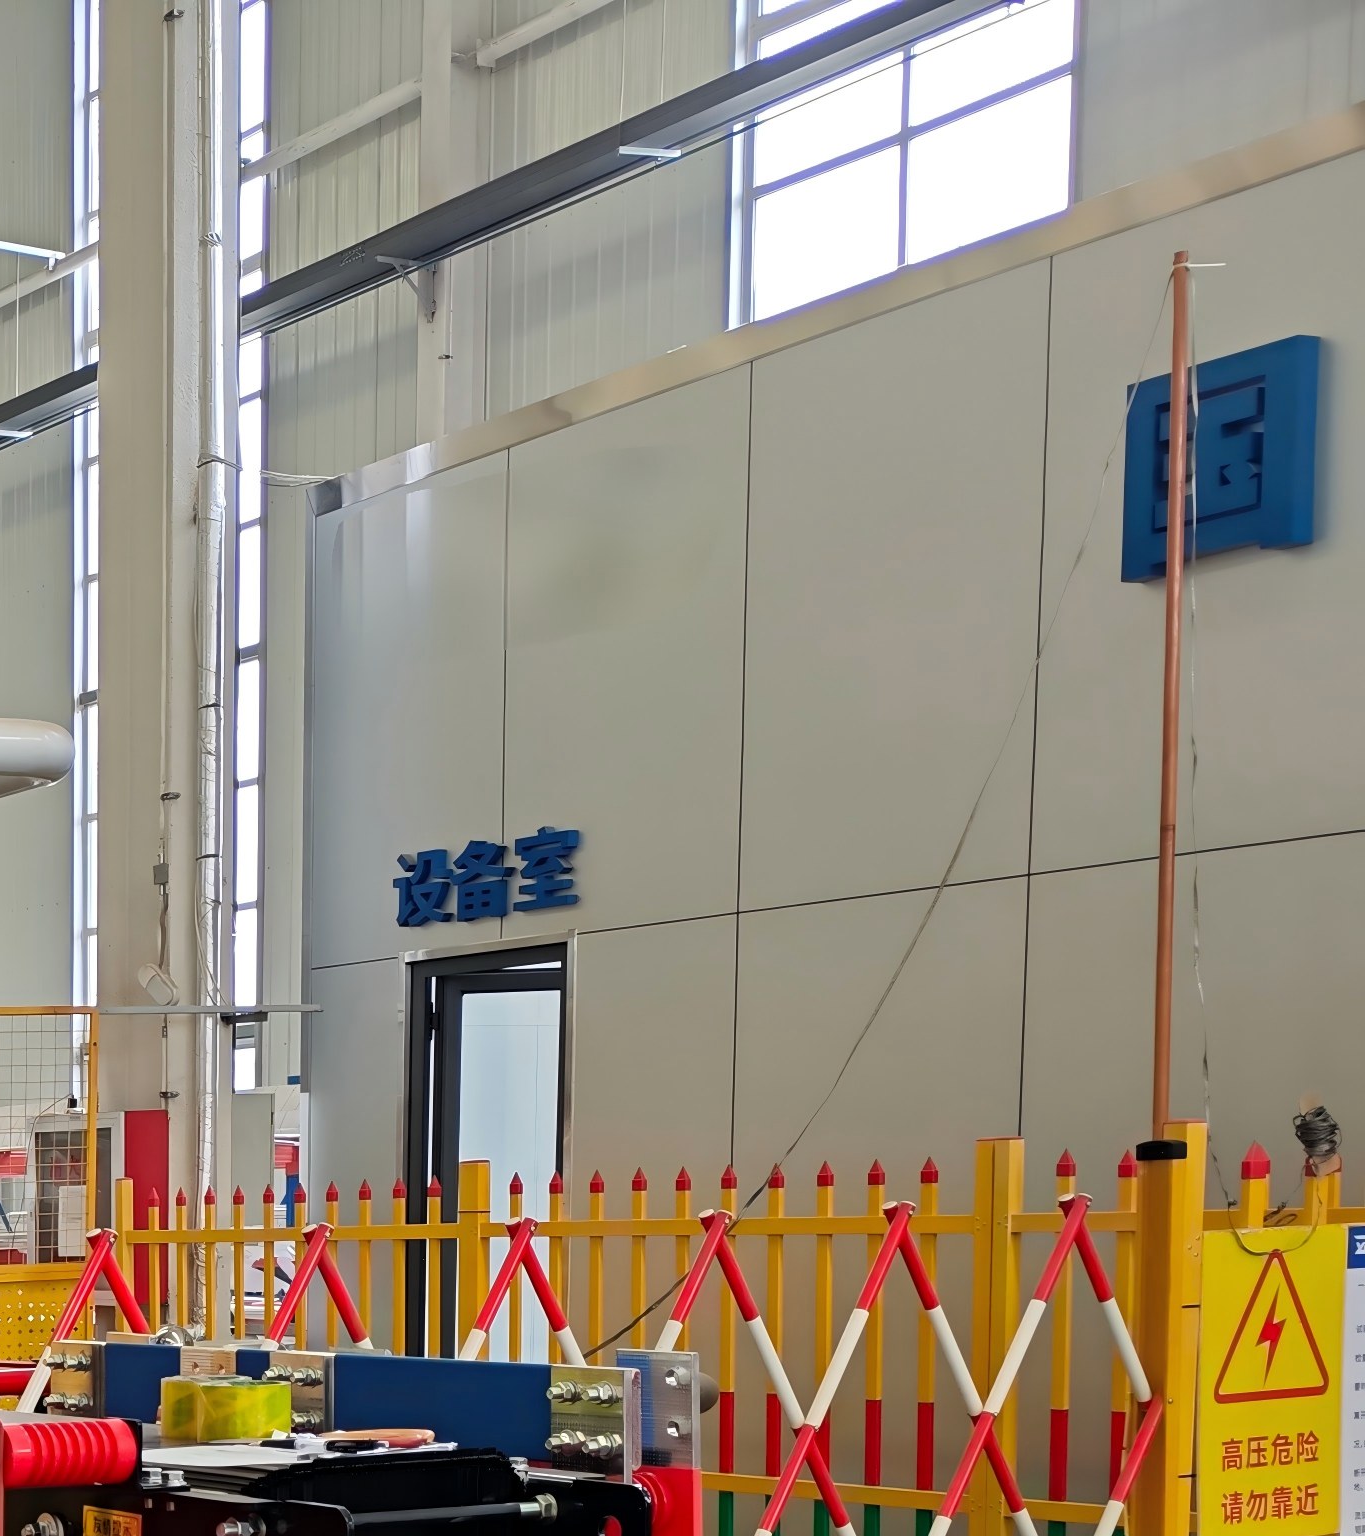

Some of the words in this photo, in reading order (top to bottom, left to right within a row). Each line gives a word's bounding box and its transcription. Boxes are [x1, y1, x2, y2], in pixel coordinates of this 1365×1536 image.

[392, 826, 581, 927] 设备室
[1221, 1430, 1319, 1472] 高压危险
[1221, 1483, 1319, 1525] 请勿靠近
